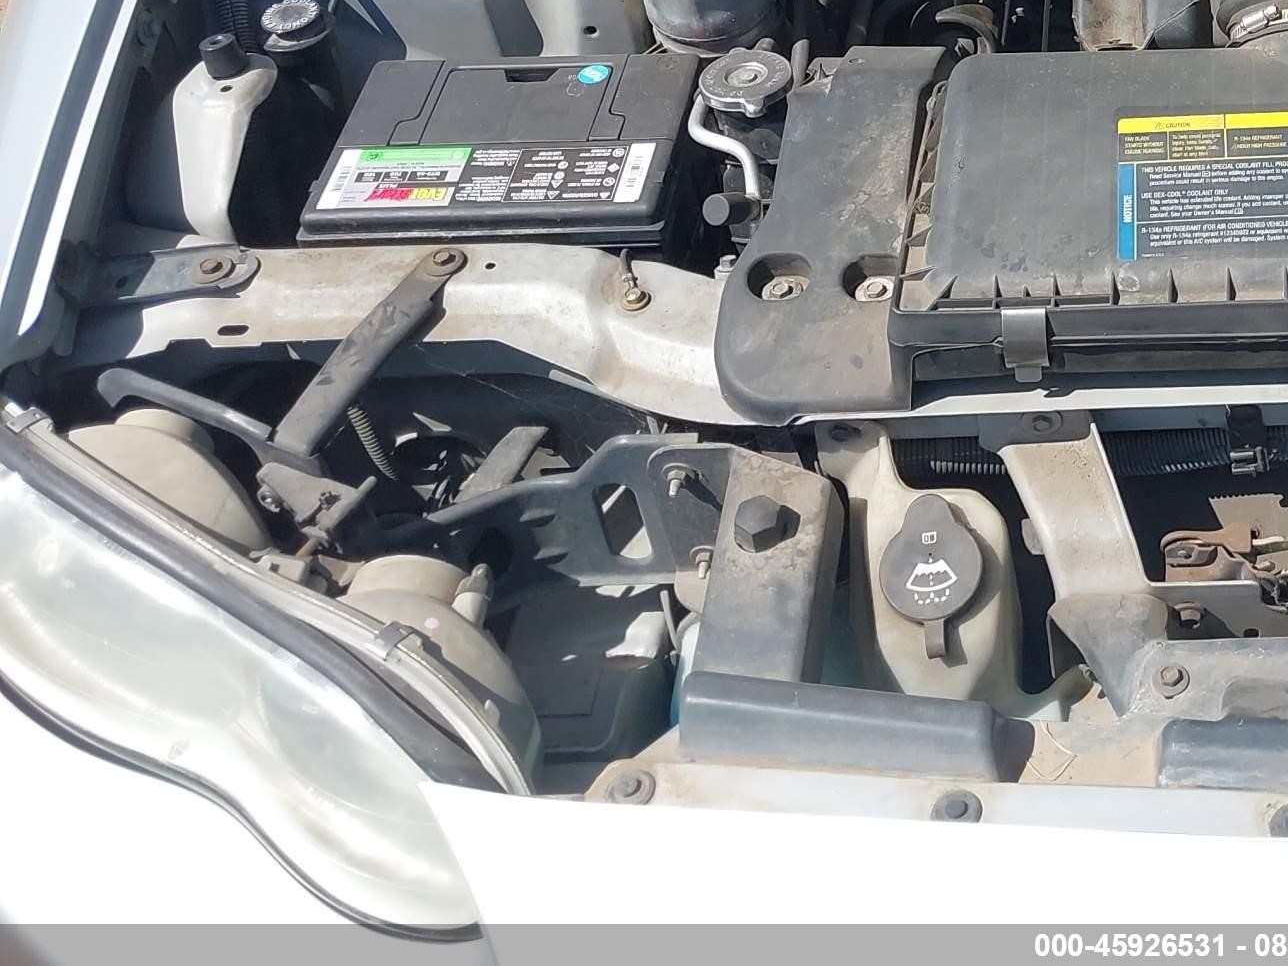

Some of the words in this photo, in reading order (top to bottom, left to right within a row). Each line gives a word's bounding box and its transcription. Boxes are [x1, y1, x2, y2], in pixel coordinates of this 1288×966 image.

[1212, 162, 1234, 170] SPECIAL
[1123, 194, 1132, 223] NOTICE
[1163, 224, 1201, 232] REFRIGERANT
[1227, 221, 1265, 229] CONDITIONED
